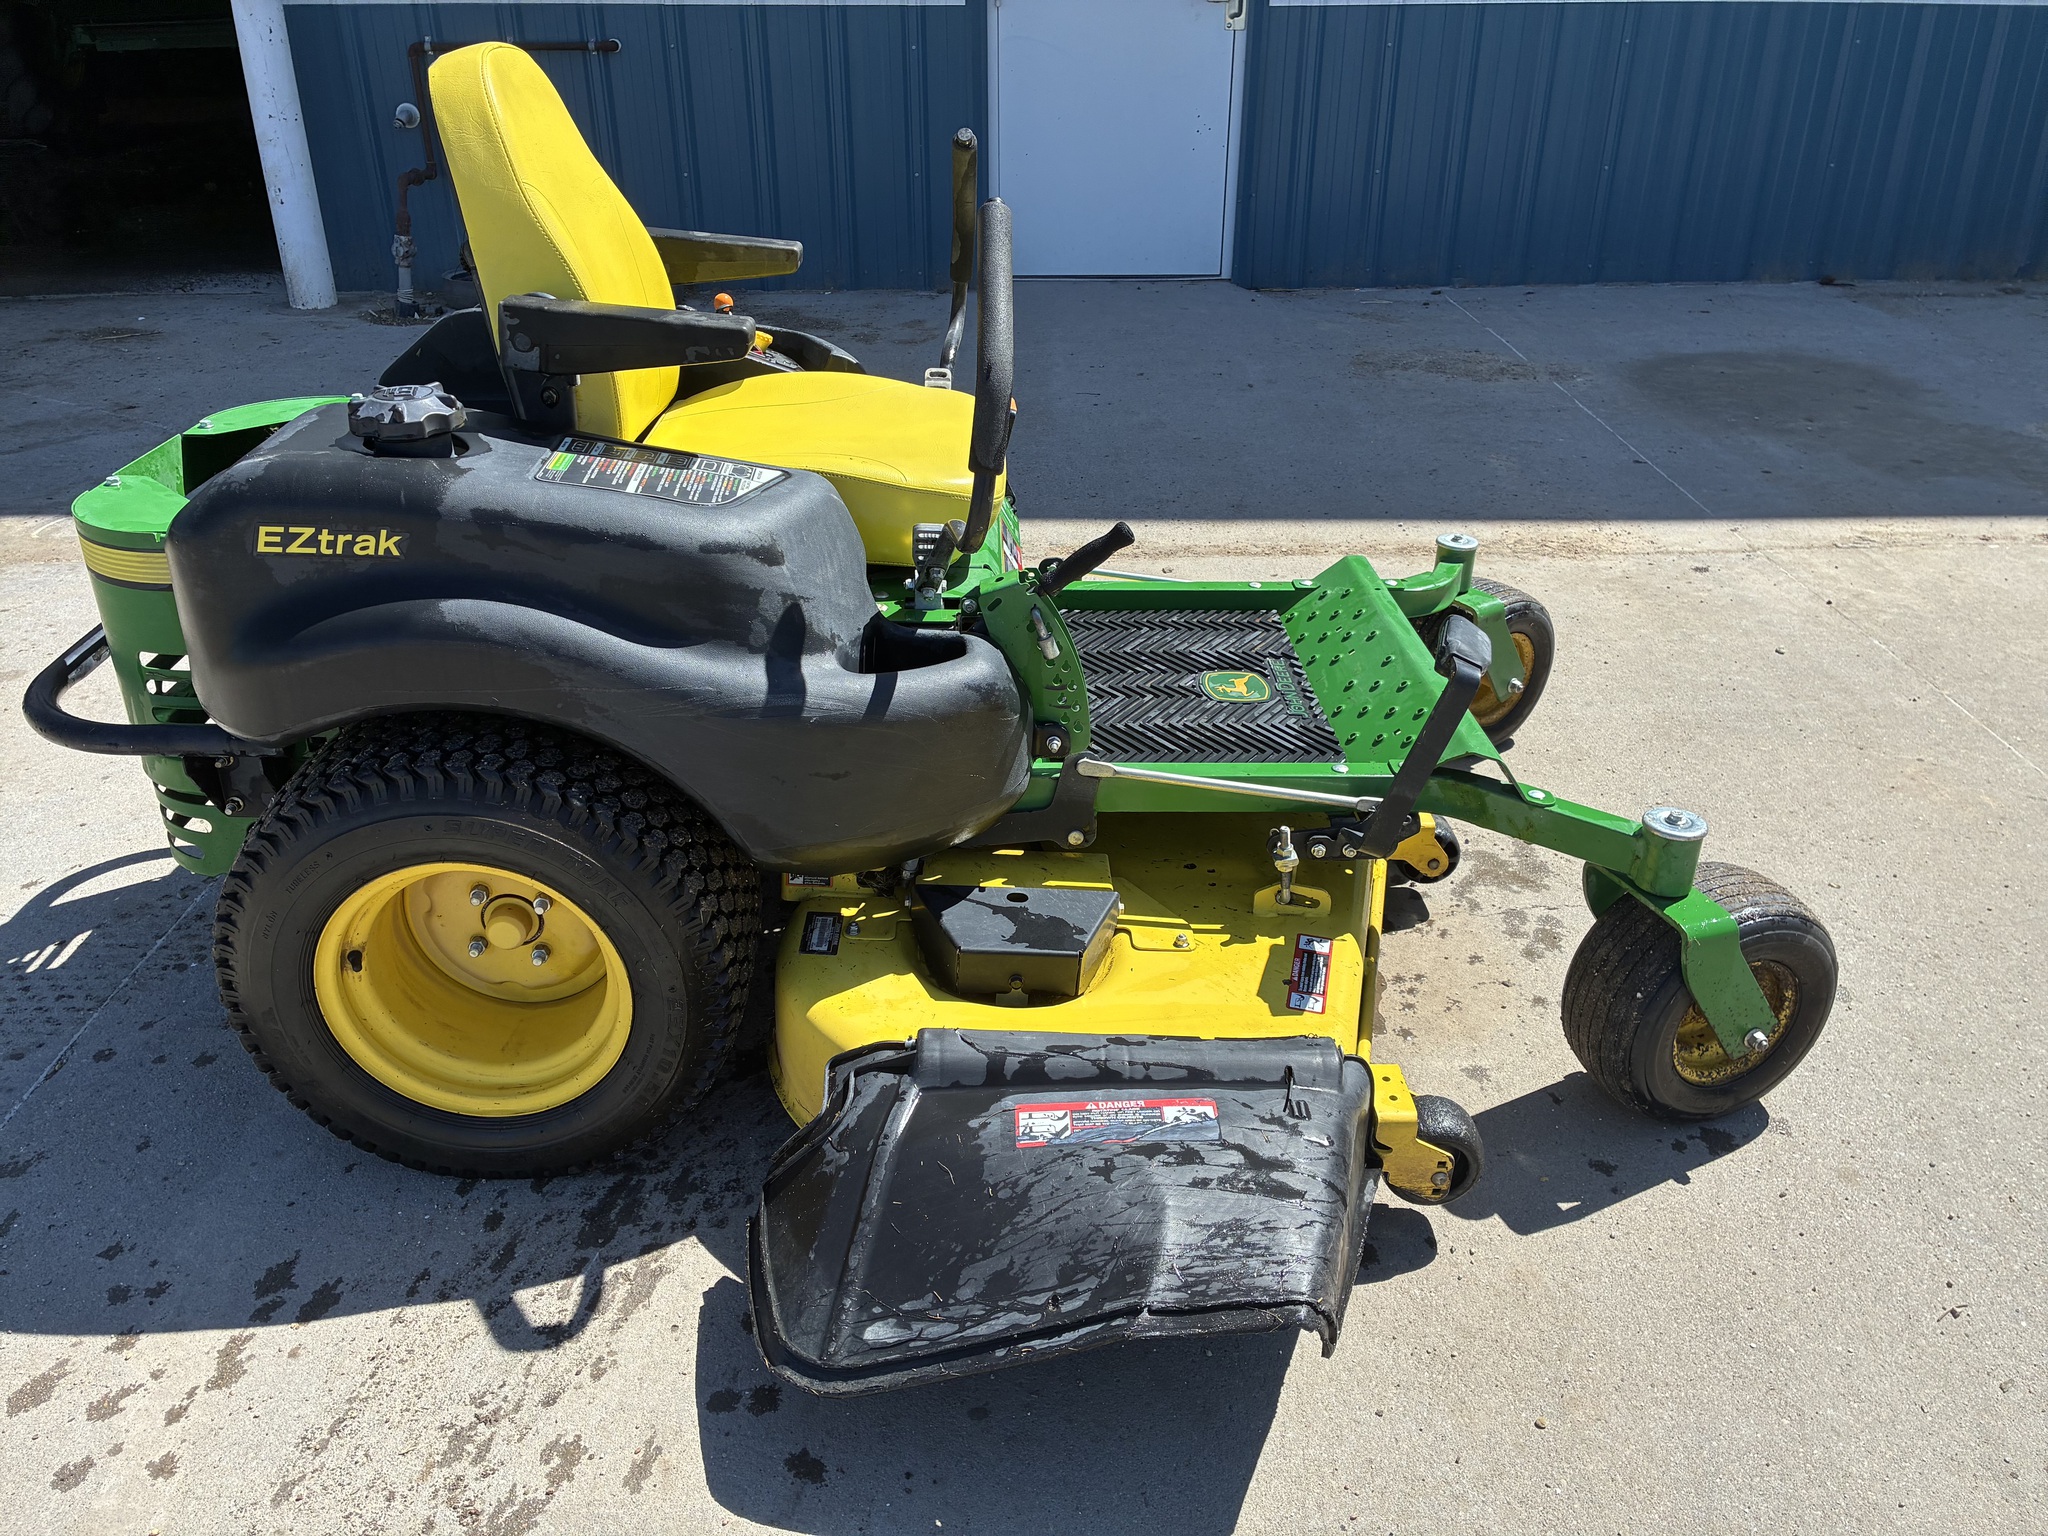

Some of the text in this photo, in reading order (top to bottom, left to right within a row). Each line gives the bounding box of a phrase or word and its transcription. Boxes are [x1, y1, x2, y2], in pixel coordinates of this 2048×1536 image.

[257, 525, 403, 557] EZtrak
[1271, 659, 1310, 719] JOHN DEERE
[442, 819, 549, 853] SUPER
[1099, 1100, 1145, 1108] DANGER
